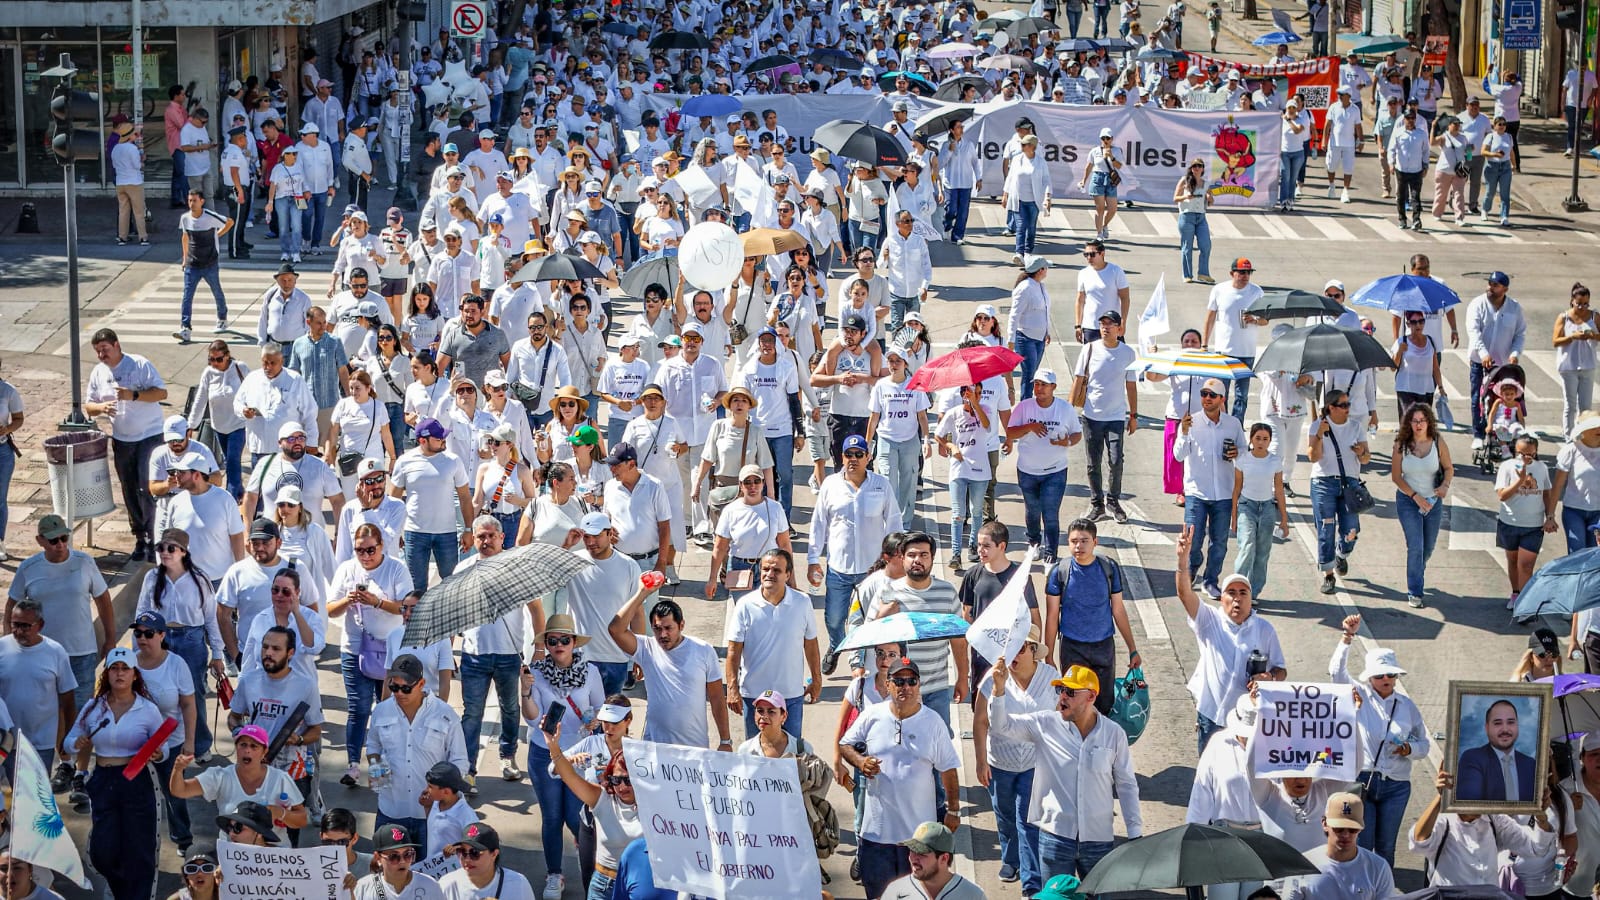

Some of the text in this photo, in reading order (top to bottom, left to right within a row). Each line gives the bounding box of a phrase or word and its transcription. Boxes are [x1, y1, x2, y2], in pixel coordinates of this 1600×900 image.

[888, 410, 909, 419] 7/09
[1290, 684, 1321, 700] YO
[1275, 696, 1339, 720] PERDÍ
[1261, 718, 1353, 739] UN HIJO
[634, 757, 794, 794] SI NO HAY JUSTICIA PARA
[675, 789, 755, 817] EL PUEBLO
[651, 813, 677, 836] QUE
[680, 821, 699, 840] NO
[734, 831, 763, 848] PAZ
[768, 834, 799, 849] PARA
[226, 849, 305, 866] LOS BUENOS
[320, 850, 341, 880] PAZ
[695, 851, 713, 873] EL
[234, 864, 274, 877] SOMOS
[228, 882, 296, 896] CULIACÁN
